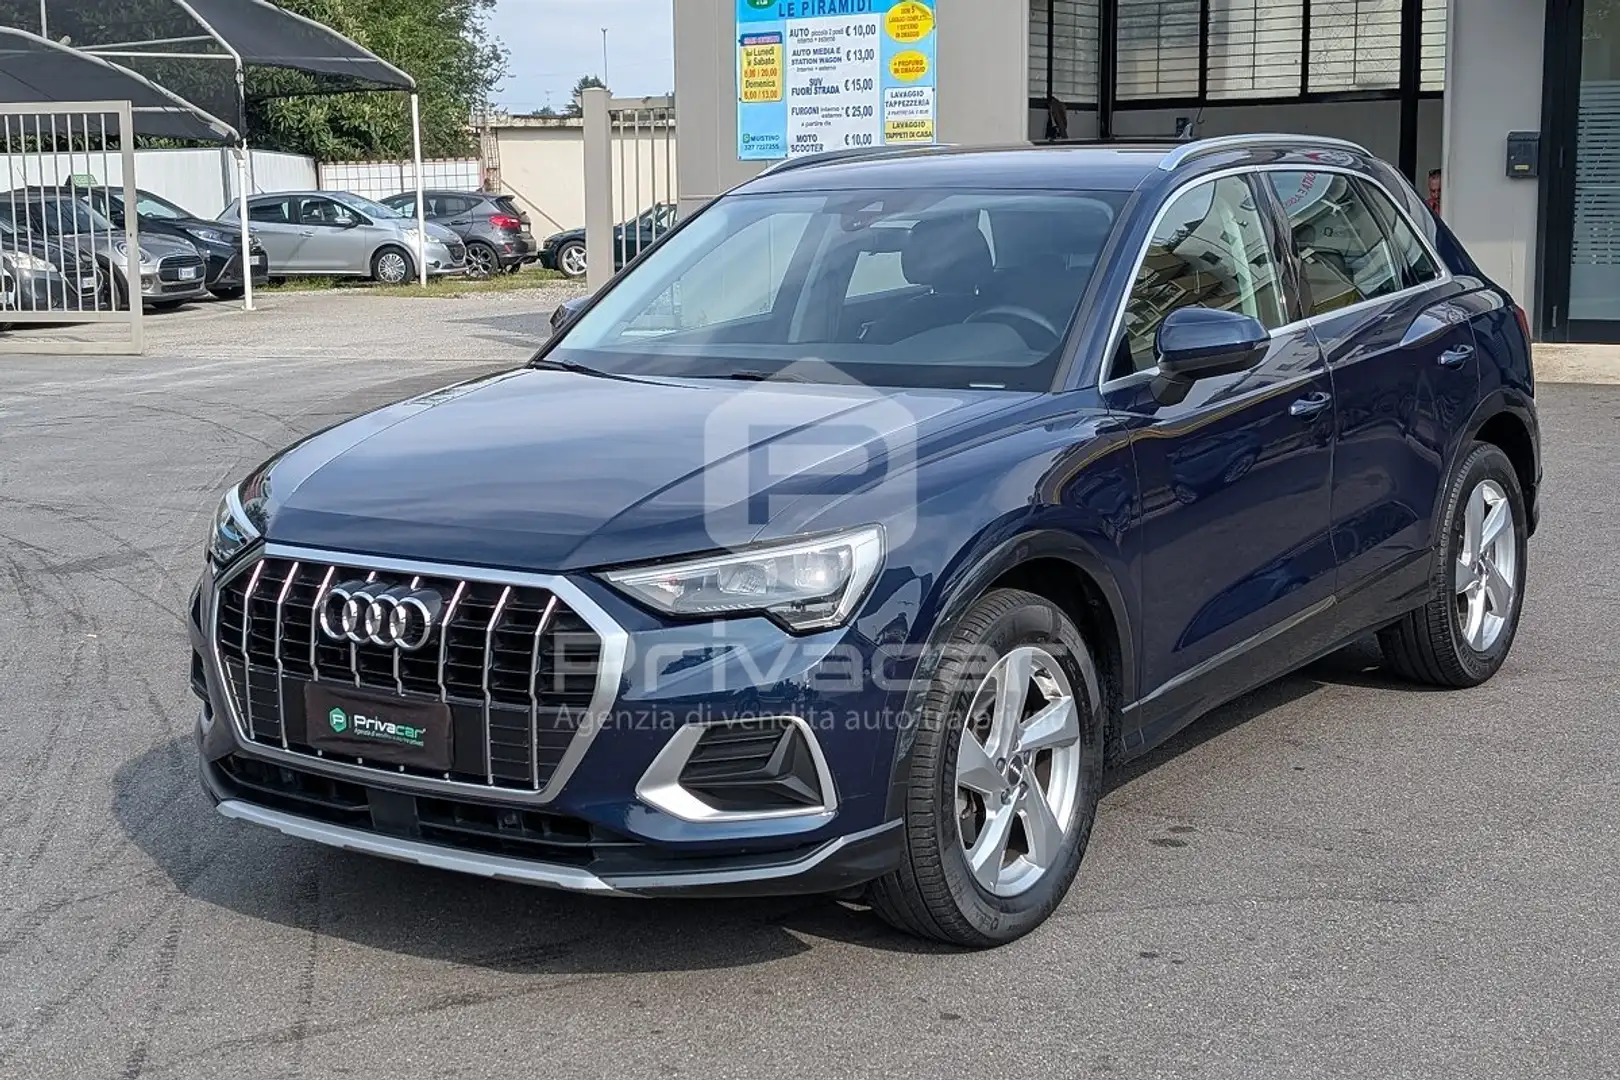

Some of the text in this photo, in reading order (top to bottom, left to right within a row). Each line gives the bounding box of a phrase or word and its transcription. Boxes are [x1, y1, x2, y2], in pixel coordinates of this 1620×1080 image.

[779, 0, 872, 18] LE PIRAMIDI
[789, 28, 809, 38] AUTO
[845, 25, 851, 36] €
[853, 24, 876, 38] 10,00
[792, 48, 811, 57] AUTO
[813, 47, 835, 56] MEDIA
[846, 50, 852, 62] €
[853, 48, 875, 63] 13,00
[753, 57, 775, 66] Sabato
[791, 56, 842, 66] STATION WAGON
[745, 79, 776, 89] Domenica
[808, 77, 873, 93] SUV € 15,00
[791, 85, 840, 96] FUORI STRADA
[890, 90, 924, 99] LAVAGGIO
[885, 99, 930, 107] TAPPEZZERIA
[791, 106, 819, 116] FURGONI
[845, 106, 851, 118] €
[851, 105, 873, 119] 25,00
[892, 121, 926, 130] LAVAGGIO
[915, 130, 933, 138] CASA
[796, 133, 872, 146] MOTO € 10,00
[791, 143, 824, 153] SCOOTER
[353, 714, 427, 739] Privacar
